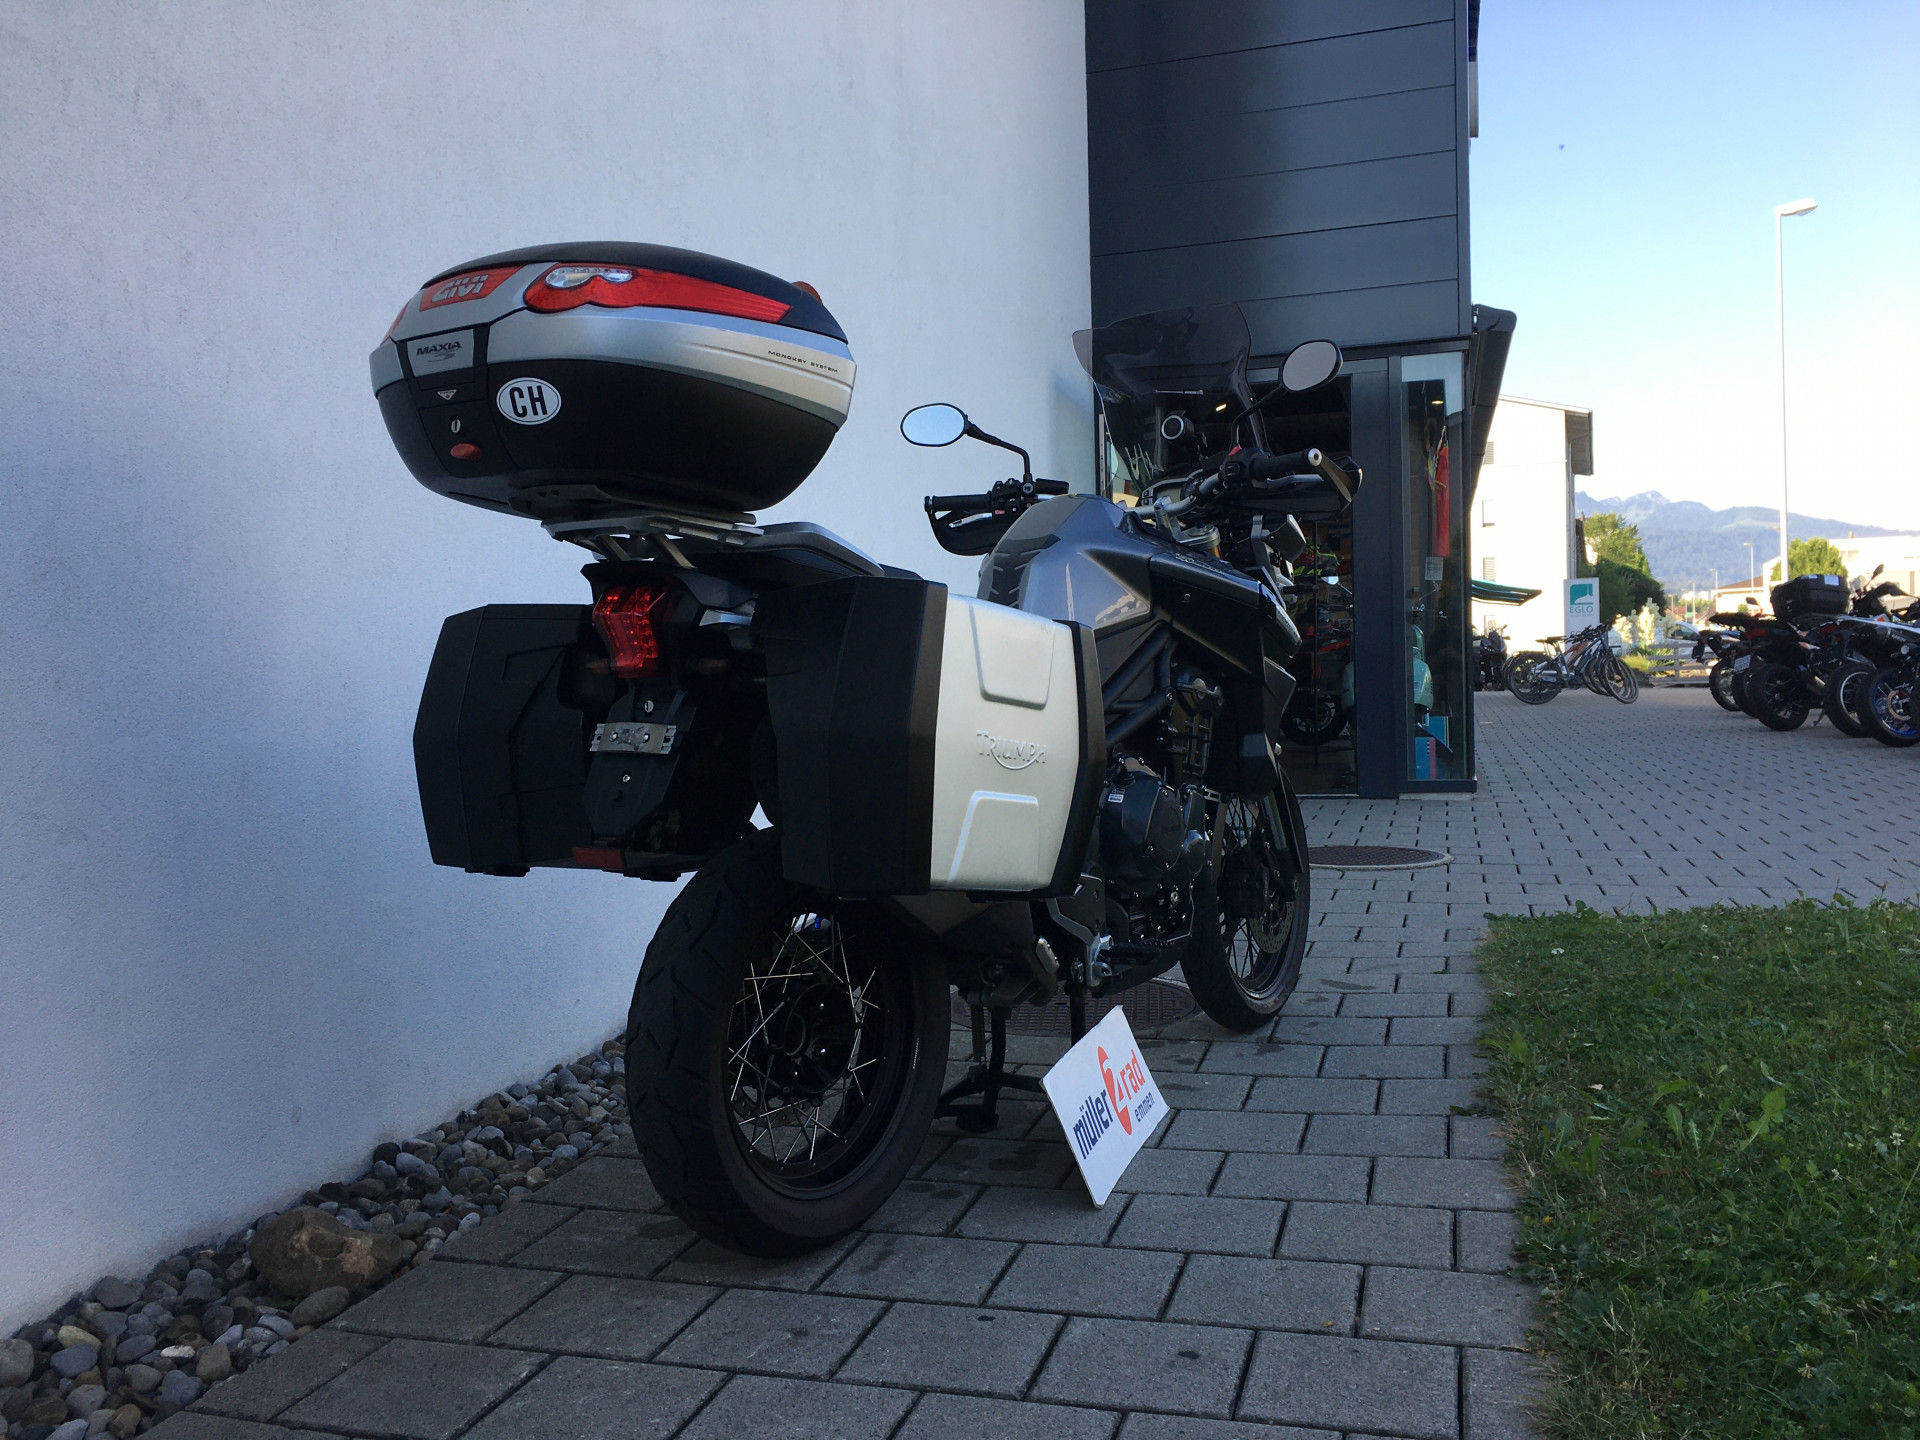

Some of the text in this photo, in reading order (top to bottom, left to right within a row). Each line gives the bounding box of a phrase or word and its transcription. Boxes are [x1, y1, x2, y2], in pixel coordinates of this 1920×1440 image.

[431, 275, 489, 302] GIVI
[416, 341, 462, 356] MAXIA
[768, 350, 838, 373] MONOKEY SYSTEM
[509, 385, 548, 418] CH
[1570, 605, 1594, 614] EGLO
[1134, 1092, 1155, 1123] emmen
[1073, 1089, 1113, 1160] müller
